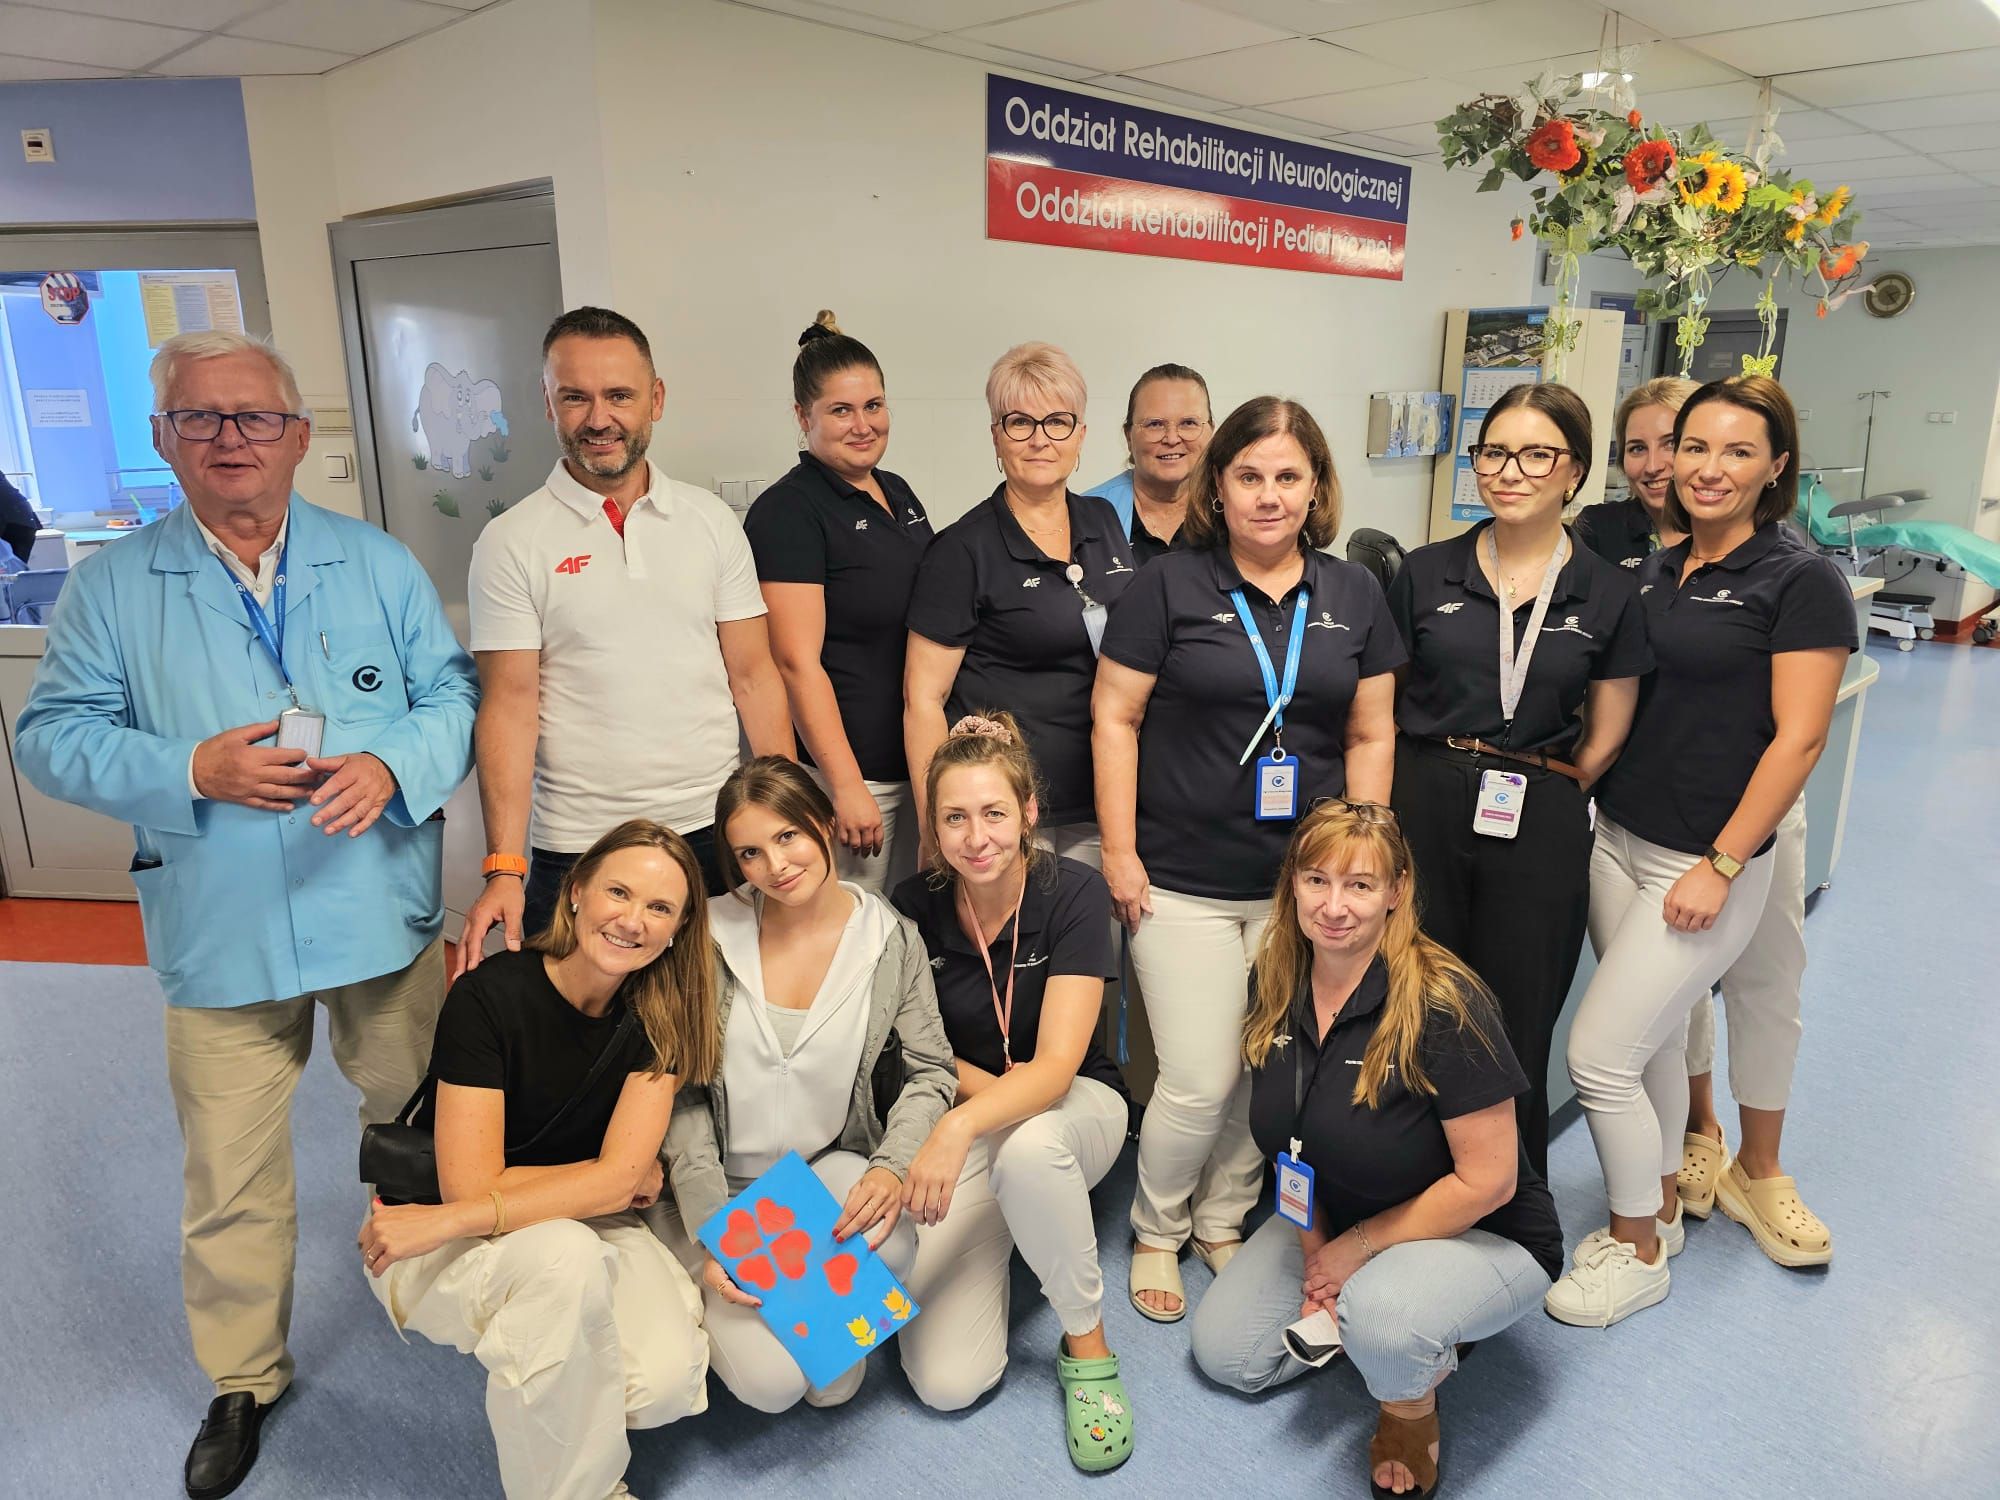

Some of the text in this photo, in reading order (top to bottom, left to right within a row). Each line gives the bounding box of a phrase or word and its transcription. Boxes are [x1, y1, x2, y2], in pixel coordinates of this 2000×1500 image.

[1005, 96, 1402, 209] Oddział Rehabilitacji Neurologicznej
[1015, 181, 1124, 230] Oddział
[1130, 201, 1268, 253] Rehabilitacji
